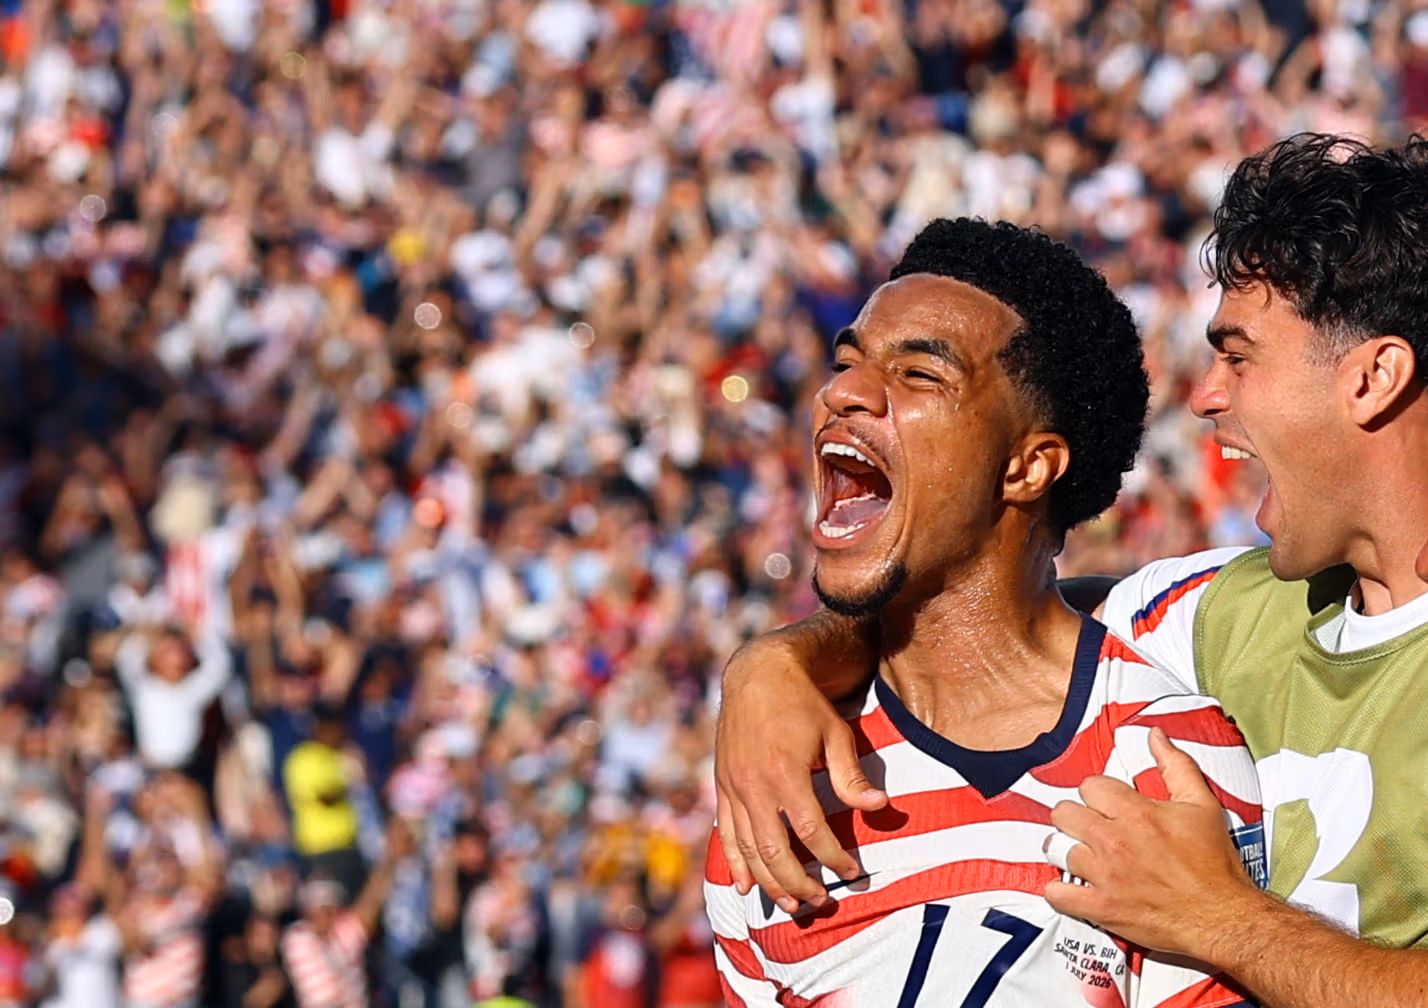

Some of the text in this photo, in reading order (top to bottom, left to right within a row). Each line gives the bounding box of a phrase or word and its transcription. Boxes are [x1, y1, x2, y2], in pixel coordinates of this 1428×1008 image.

[1054, 942, 1125, 977] SANTA CLARA, CA
[1064, 937, 1118, 959] USA VS. BIH
[1070, 966, 1087, 981] JULY
[1088, 974, 1113, 989] 2026
